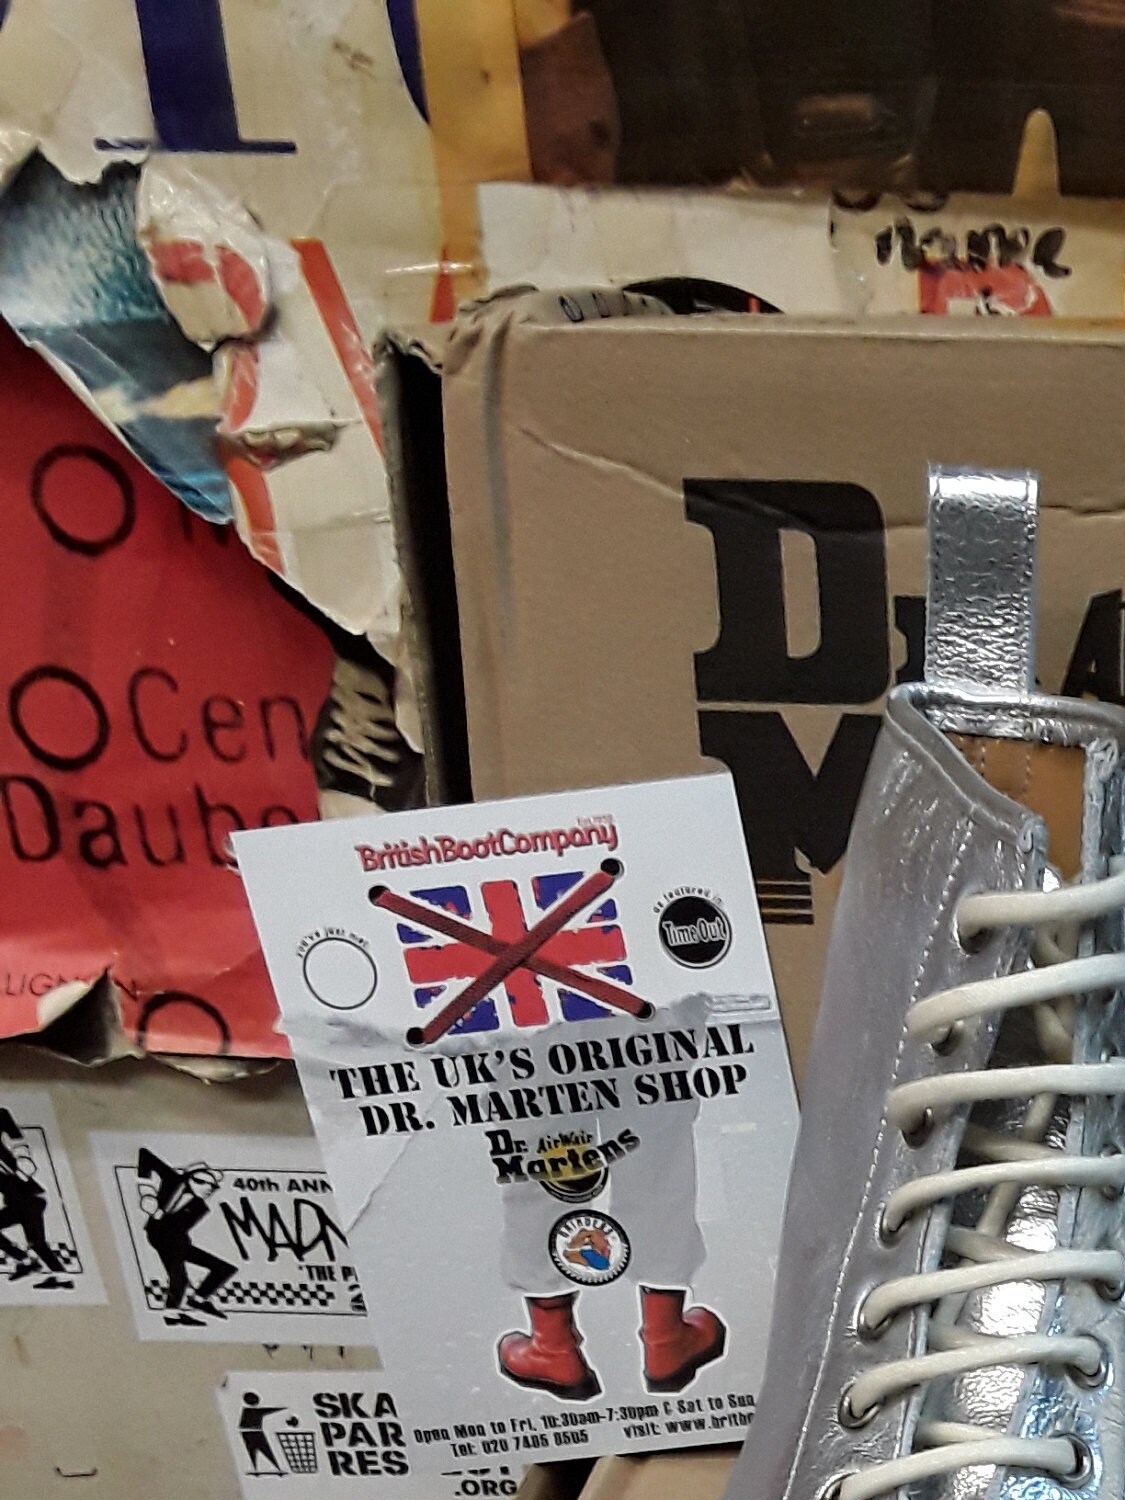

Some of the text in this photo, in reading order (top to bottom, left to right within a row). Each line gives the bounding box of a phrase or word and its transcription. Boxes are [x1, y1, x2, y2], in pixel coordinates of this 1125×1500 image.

[329, 1023, 755, 1100] THE UK'S ORIGINAL
[359, 1063, 748, 1137] DR. MARTEN SHOP
[485, 1129, 529, 1156] Dr.
[492, 1128, 641, 1184] Martens
[312, 1392, 398, 1418] SKA
[320, 1422, 407, 1448] PAR
[327, 1450, 409, 1476] RES
[454, 1480, 518, 1496] .ORG
